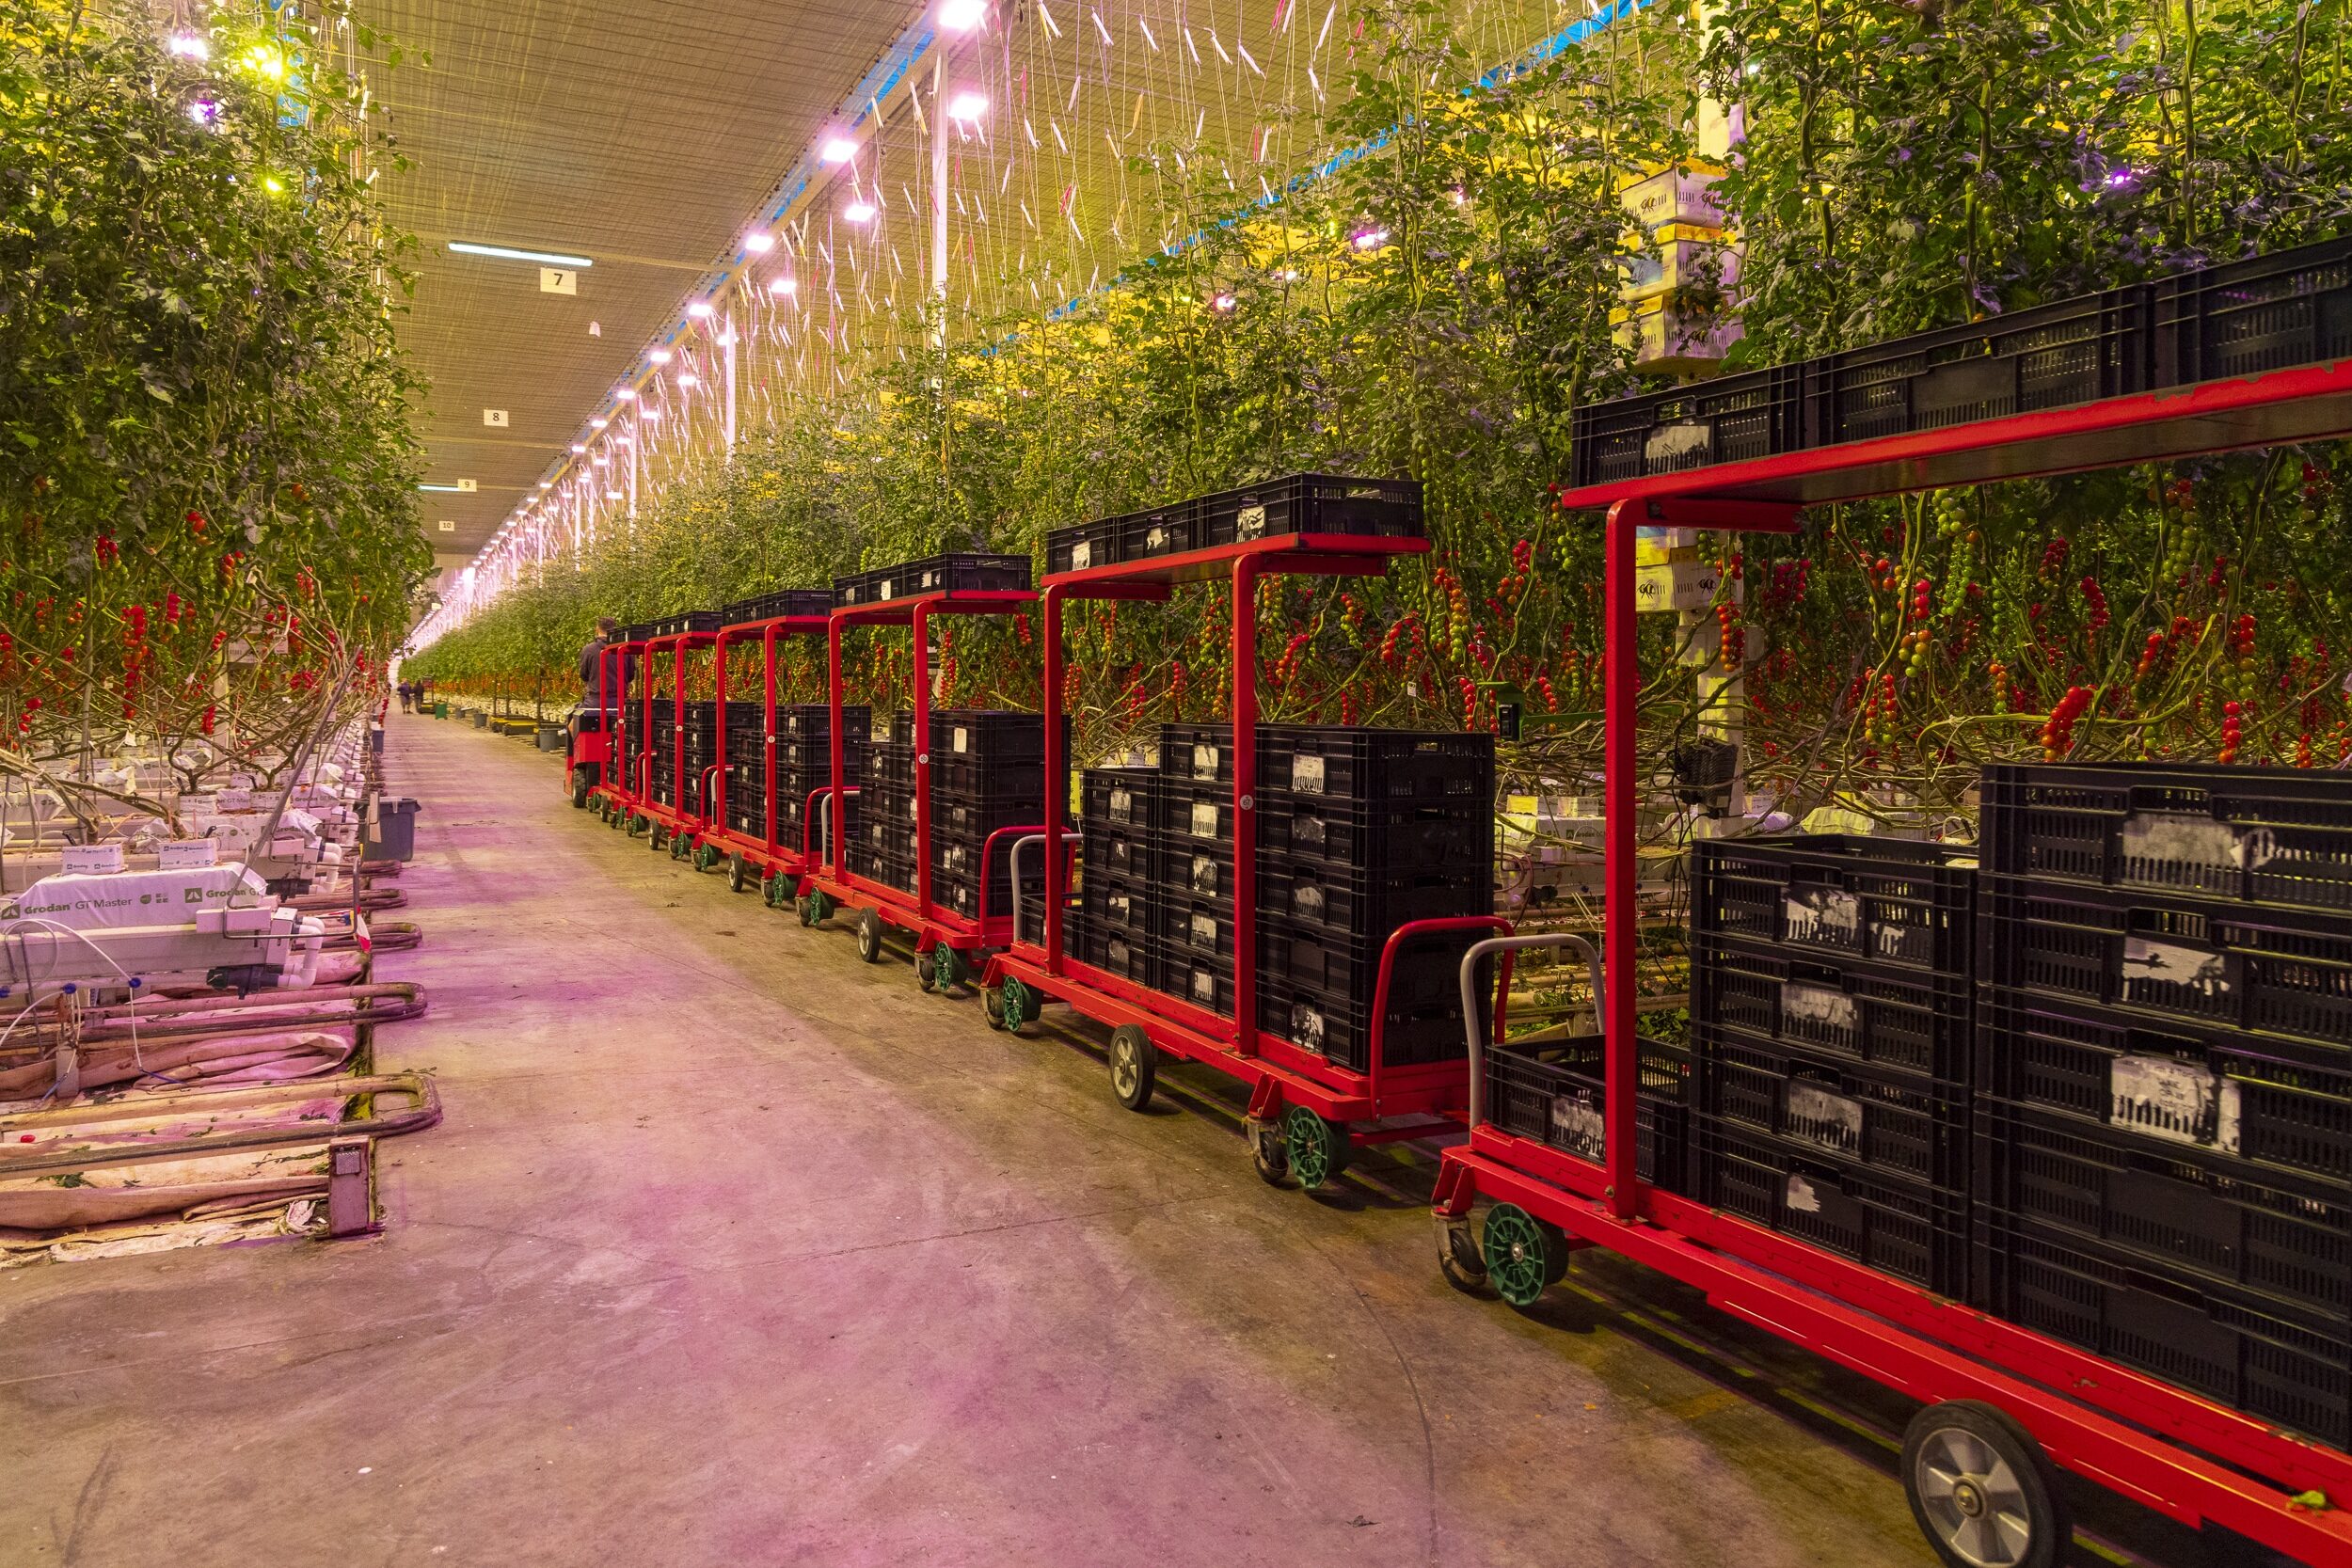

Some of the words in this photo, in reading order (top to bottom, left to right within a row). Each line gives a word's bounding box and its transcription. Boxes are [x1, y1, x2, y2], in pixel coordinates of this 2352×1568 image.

[554, 273, 563, 285] 7
[493, 413, 500, 421] 8
[24, 903, 71, 914] Grodan
[75, 900, 91, 910] GT
[93, 898, 132, 909] Master
